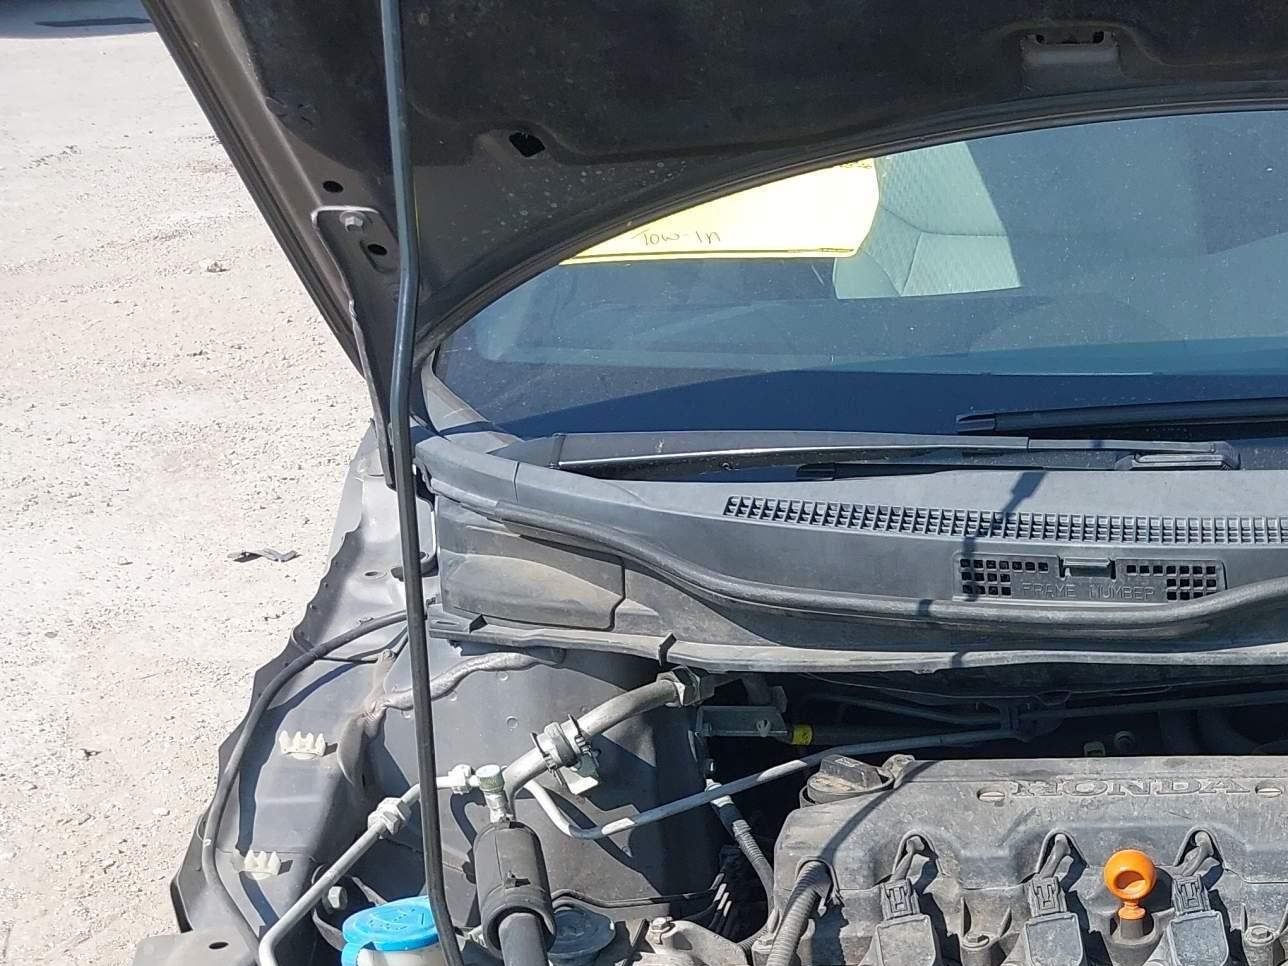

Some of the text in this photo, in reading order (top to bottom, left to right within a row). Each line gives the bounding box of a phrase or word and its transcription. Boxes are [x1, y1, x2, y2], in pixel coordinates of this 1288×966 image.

[1022, 582, 1155, 600] FRAME NUMBER
[1012, 776, 1251, 797] HONDA
